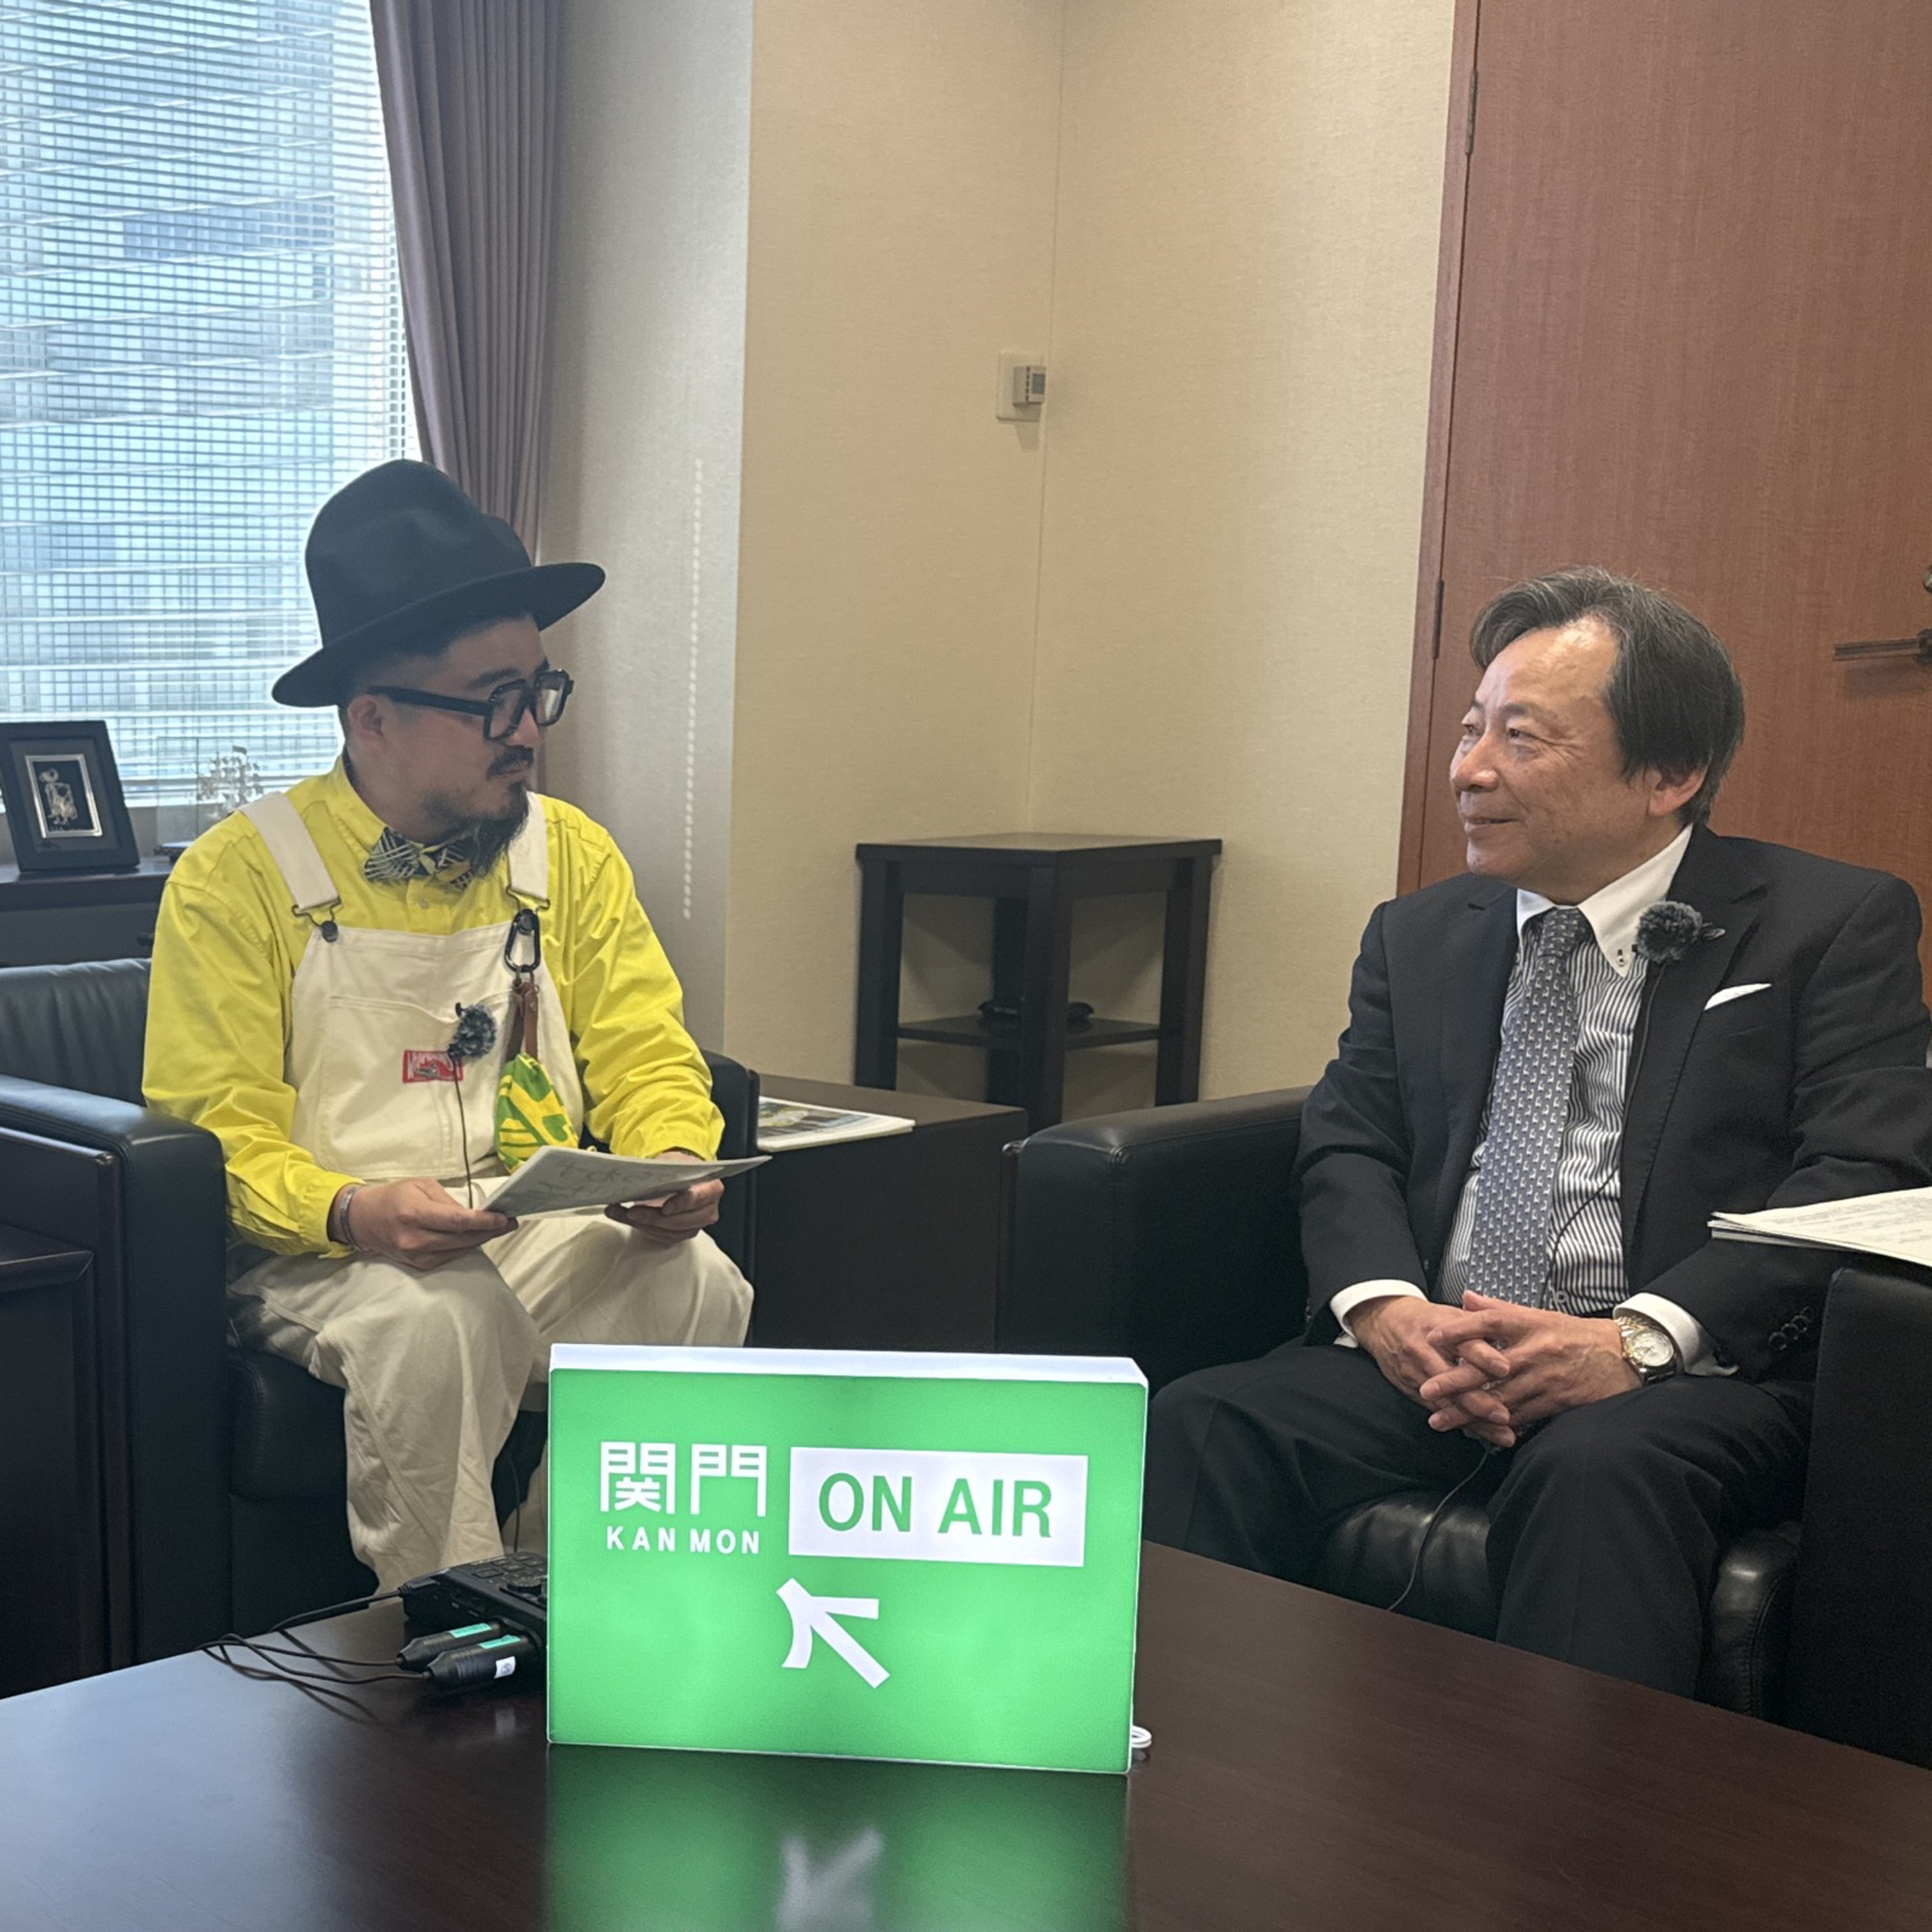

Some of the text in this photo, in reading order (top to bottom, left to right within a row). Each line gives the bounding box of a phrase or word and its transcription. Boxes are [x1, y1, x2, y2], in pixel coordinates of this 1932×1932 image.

[600, 1442, 766, 1517] 関門
[819, 1473, 1052, 1539] ON AIR
